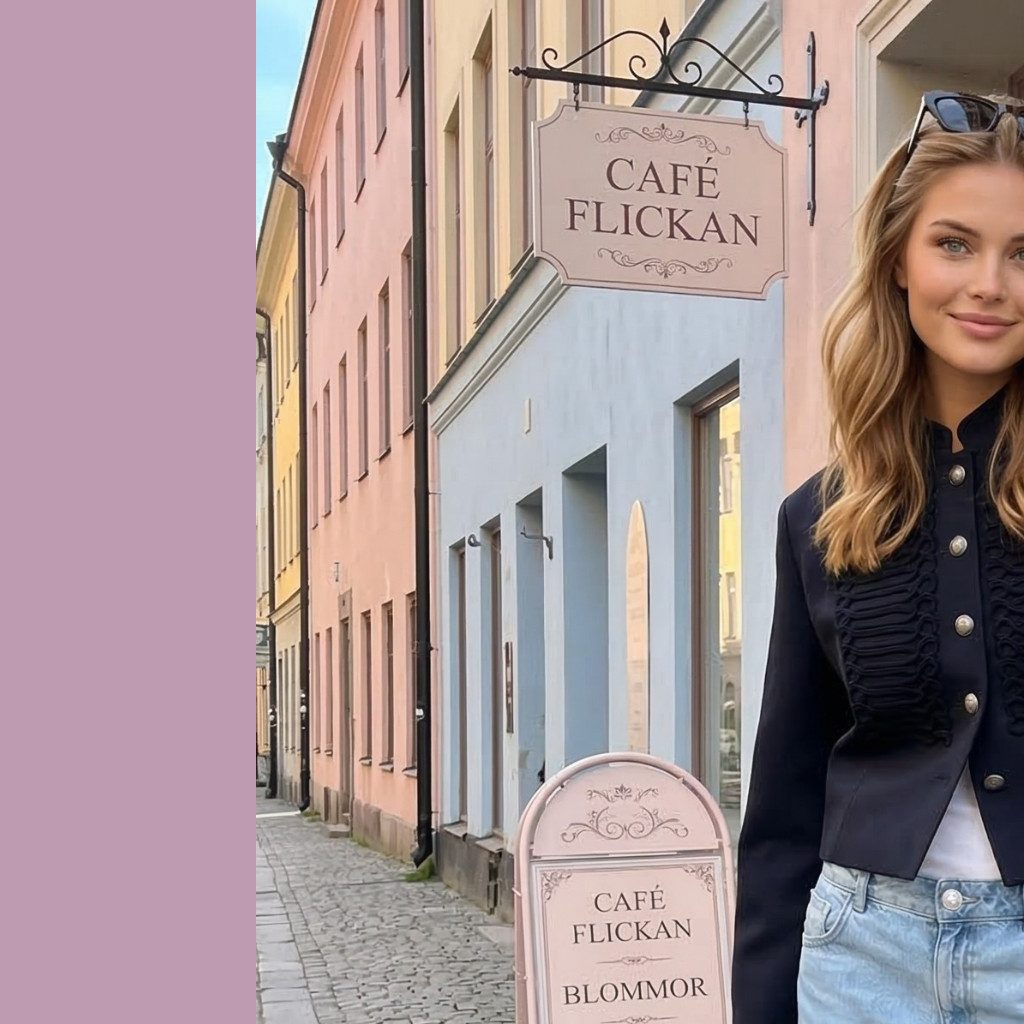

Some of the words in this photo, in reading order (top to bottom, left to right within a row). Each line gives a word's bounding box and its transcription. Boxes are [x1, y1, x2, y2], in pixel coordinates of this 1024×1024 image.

[606, 156, 720, 198] CAFÉ
[566, 198, 761, 247] FLICKAN
[594, 884, 667, 913] CAFÉ
[572, 918, 692, 945] FLICKAN
[563, 976, 708, 1005] BLOMMOR
